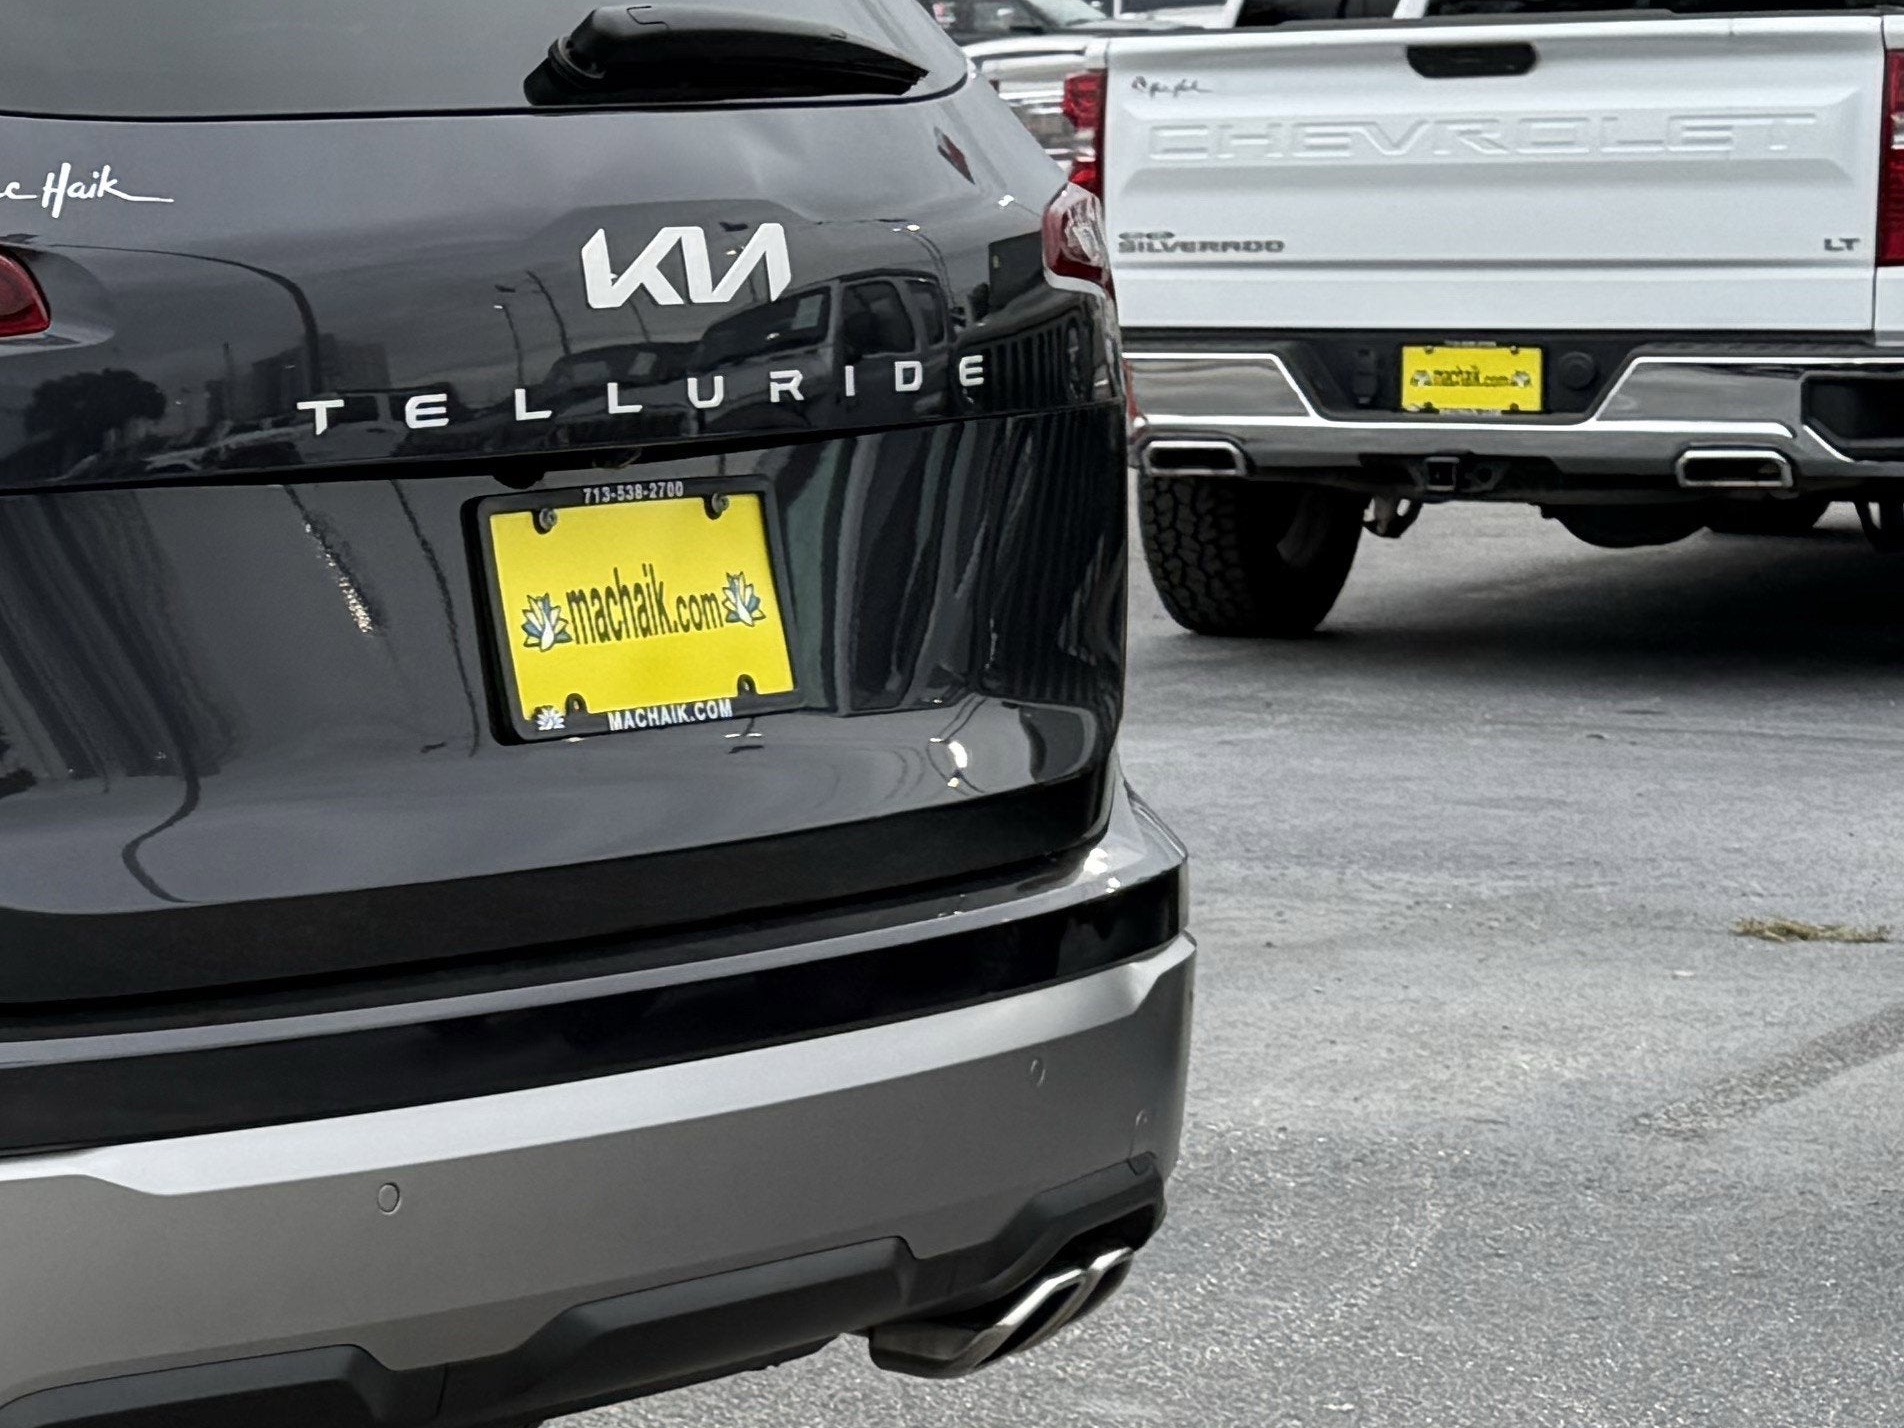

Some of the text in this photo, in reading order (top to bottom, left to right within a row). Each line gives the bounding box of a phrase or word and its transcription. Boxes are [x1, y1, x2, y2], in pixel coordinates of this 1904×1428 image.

[1148, 114, 1816, 162] CHEVROLET
[42, 162, 175, 219] Haik
[580, 222, 792, 310] KIA
[1118, 239, 1286, 254] SILVERADO
[1823, 237, 1861, 251] LT
[296, 354, 985, 437] TELLURIDE
[582, 480, 685, 504] 713-538-2700
[565, 562, 725, 646] machaik.com
[607, 698, 734, 731] MACHAIK.COM
